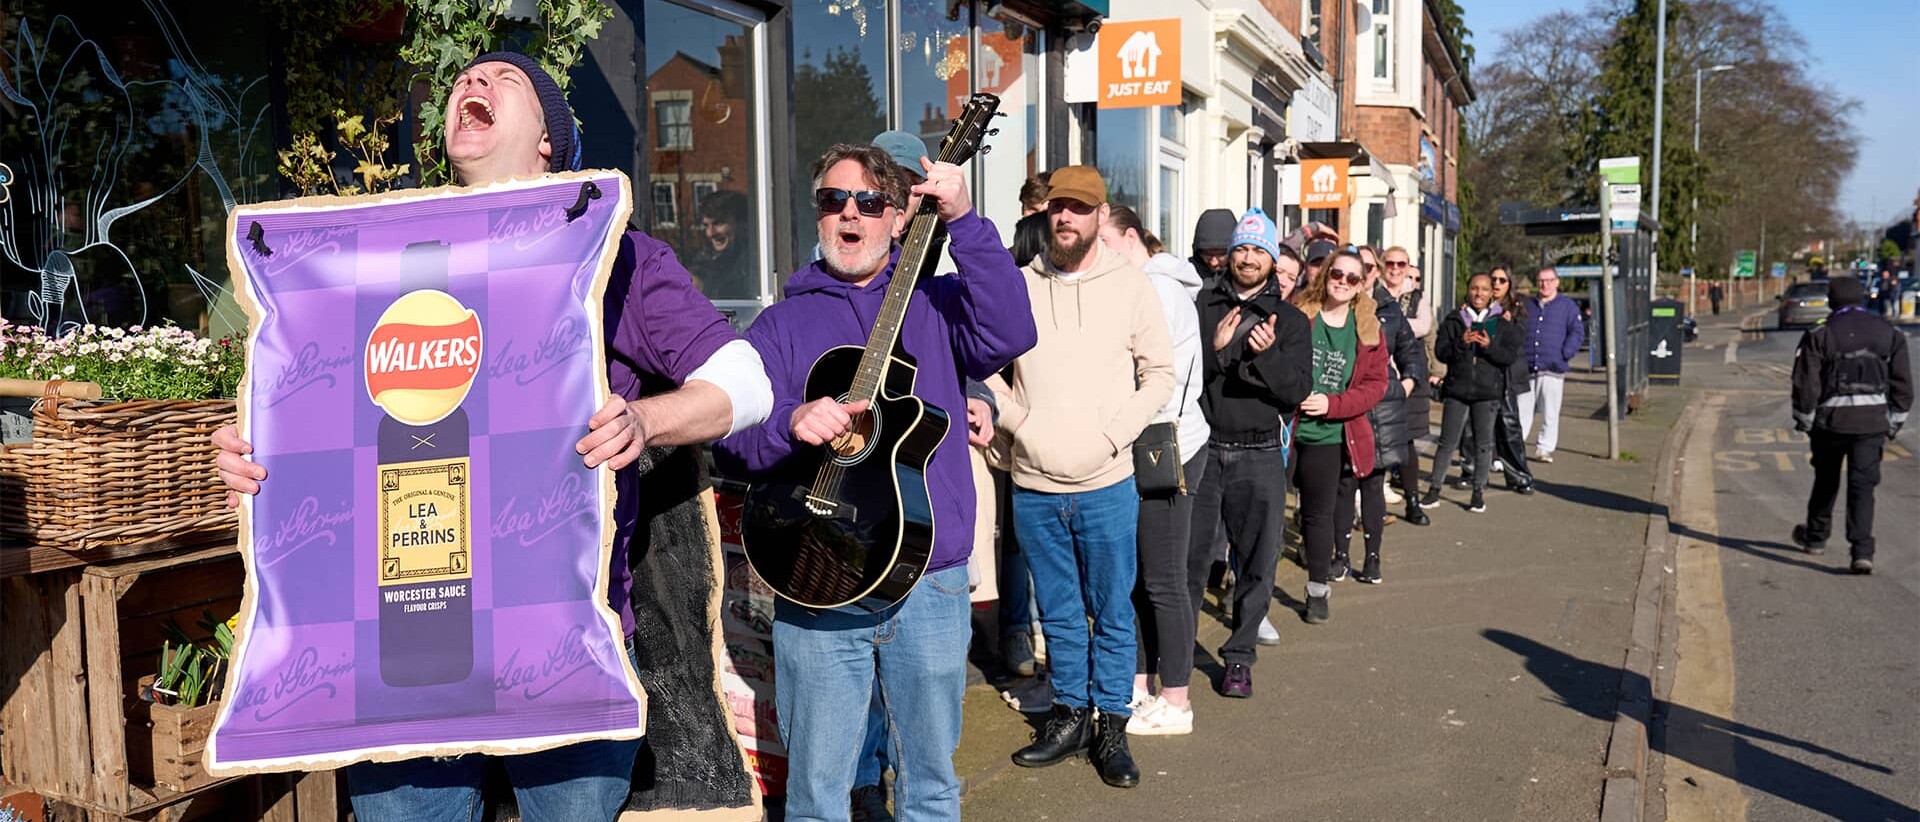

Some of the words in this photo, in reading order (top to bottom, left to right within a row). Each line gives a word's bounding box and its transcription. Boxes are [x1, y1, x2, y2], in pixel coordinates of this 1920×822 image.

[1107, 82, 1142, 99] JUST
[1143, 80, 1172, 95] EAT
[370, 336, 478, 374] WALKERS
[1733, 428, 1811, 445] BU
[403, 489, 428, 500] ORIGINAL
[409, 502, 438, 519] LEA
[419, 519, 427, 530] &
[392, 528, 456, 548] PERRINS
[384, 588, 437, 603] WORCESTER
[438, 585, 467, 599] SAUCE
[403, 602, 428, 613] FLAVOUR
[427, 600, 448, 611] CRISPS
